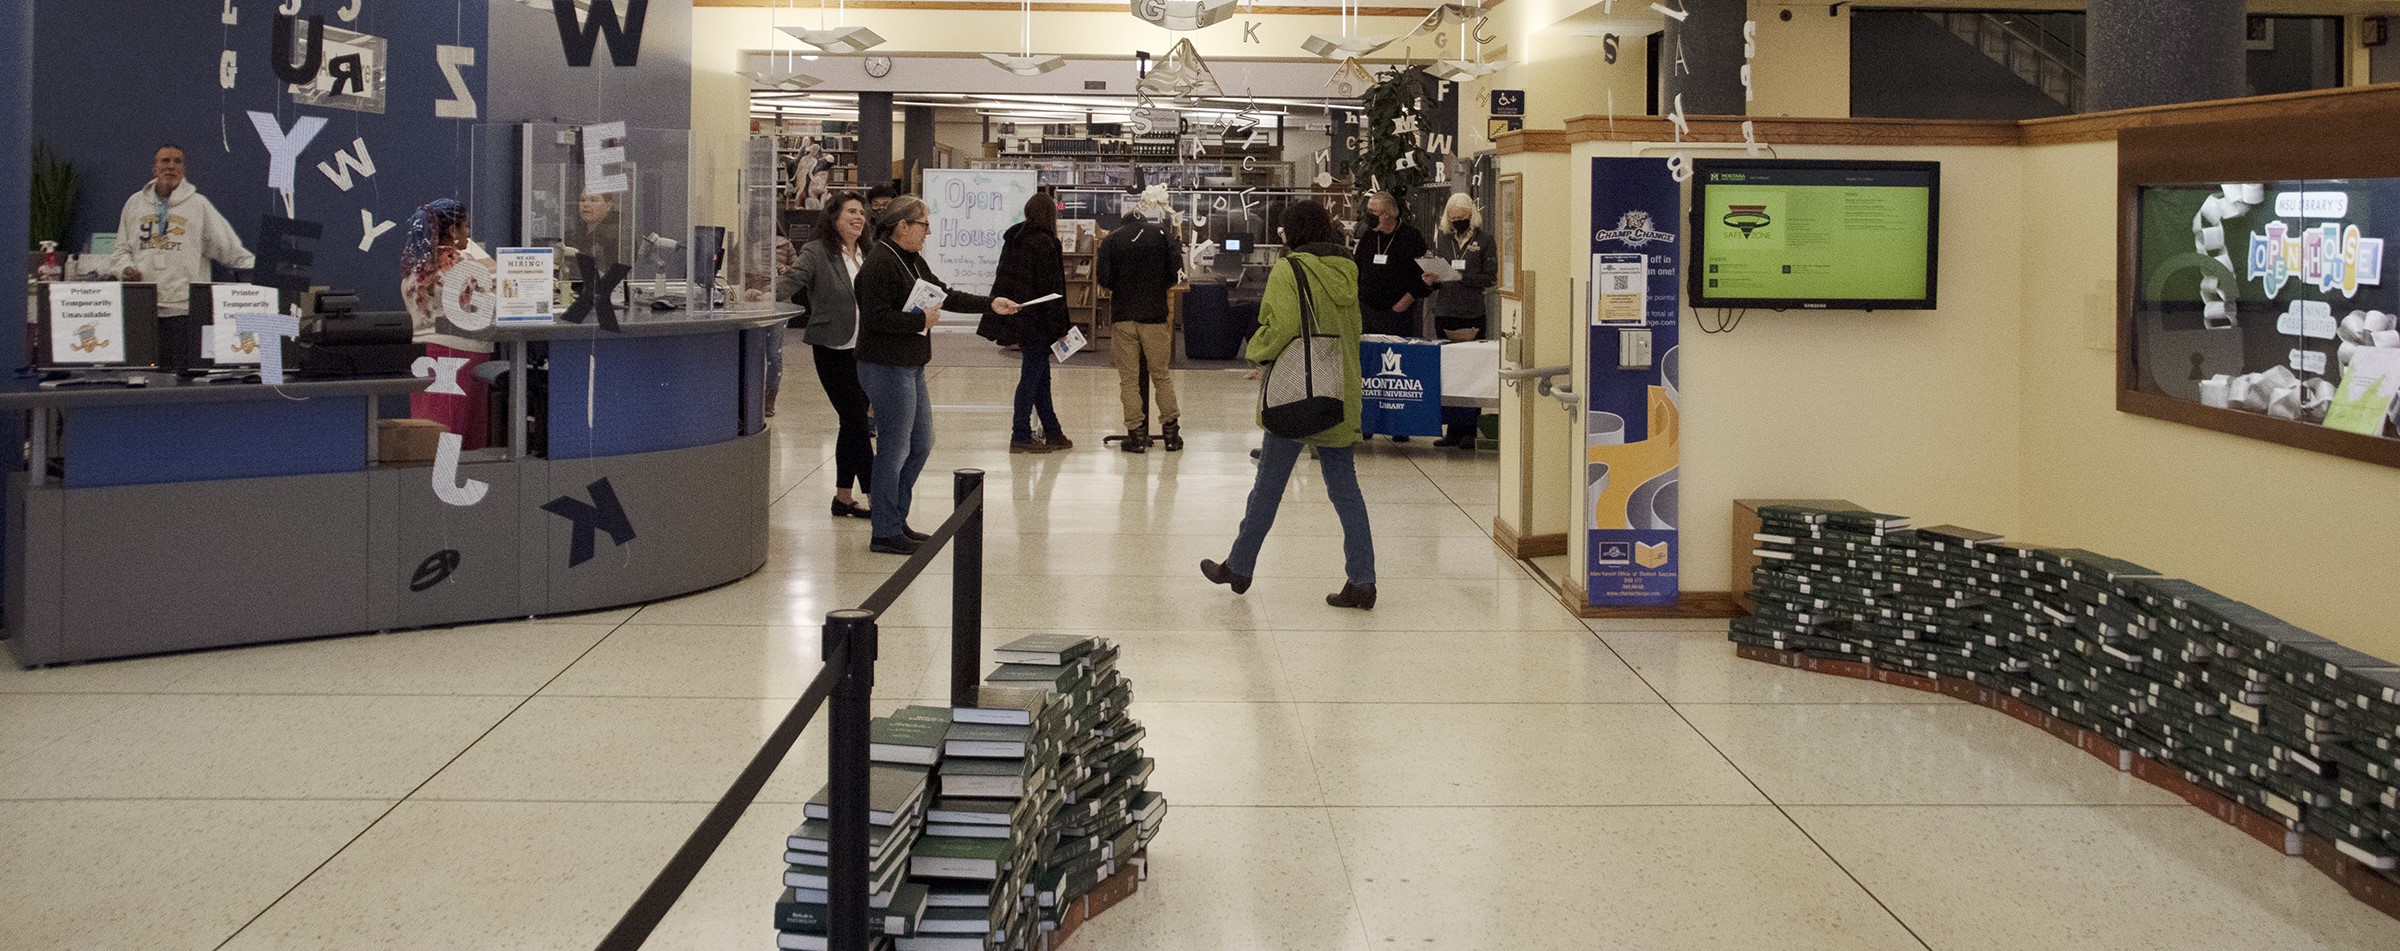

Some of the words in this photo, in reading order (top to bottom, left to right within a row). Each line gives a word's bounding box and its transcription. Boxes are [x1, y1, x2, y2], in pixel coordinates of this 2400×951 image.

[552, 0, 648, 67] W
[1243, 20, 1262, 44] K
[271, 14, 324, 85] U
[1602, 32, 1620, 65] S
[246, 110, 330, 189] Y
[582, 120, 628, 196] E
[944, 178, 1003, 220] Open
[1597, 230, 1632, 241] CHAMP
[1634, 228, 1675, 243] CHANGE
[60, 299, 113, 307] Temporarily
[71, 287, 102, 295] Printer
[222, 301, 270, 309] Temporarily
[231, 289, 260, 297] Printer
[441, 260, 498, 331] G
[61, 311, 112, 319] Unavailable
[234, 312, 300, 386] T
[1361, 377, 1424, 391] MONTANA
